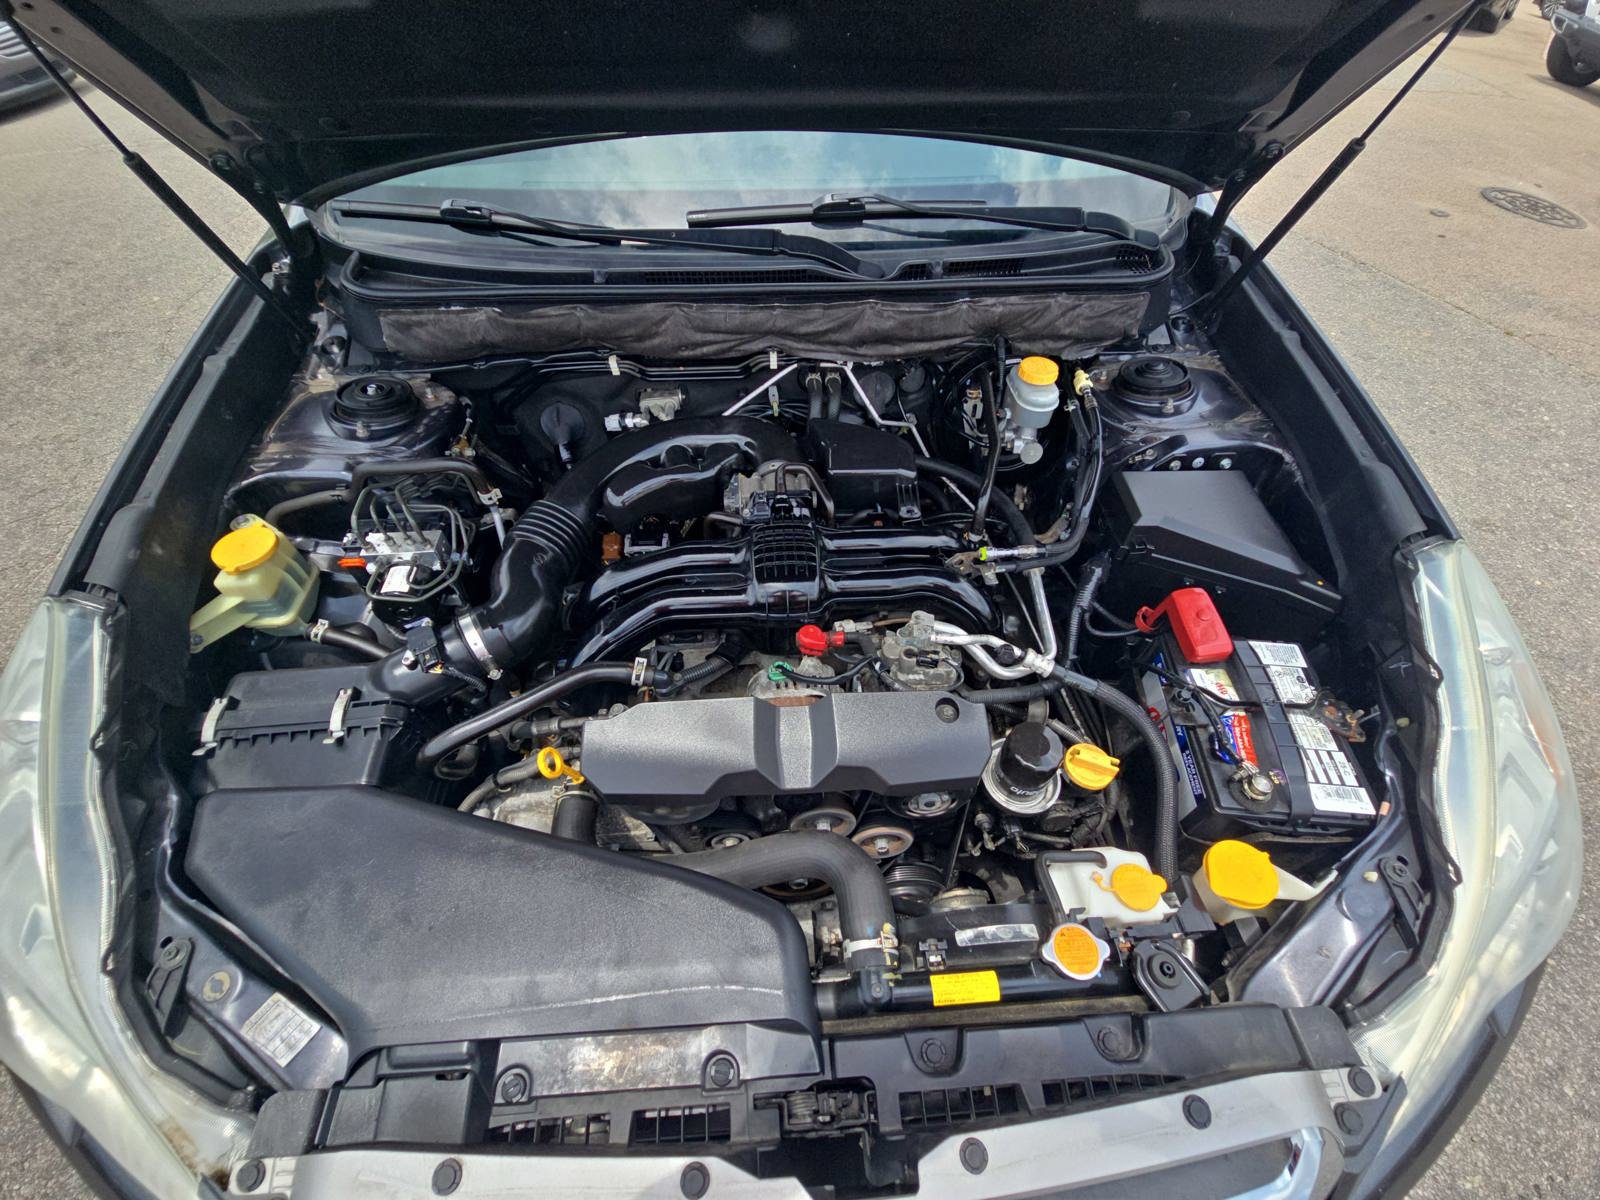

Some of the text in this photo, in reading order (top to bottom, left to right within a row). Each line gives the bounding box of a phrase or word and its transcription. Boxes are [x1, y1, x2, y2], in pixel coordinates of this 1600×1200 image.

[1182, 752, 1198, 796] REPLACEMENT
[1187, 755, 1196, 774] YEAR
[1193, 775, 1202, 794] FREE
